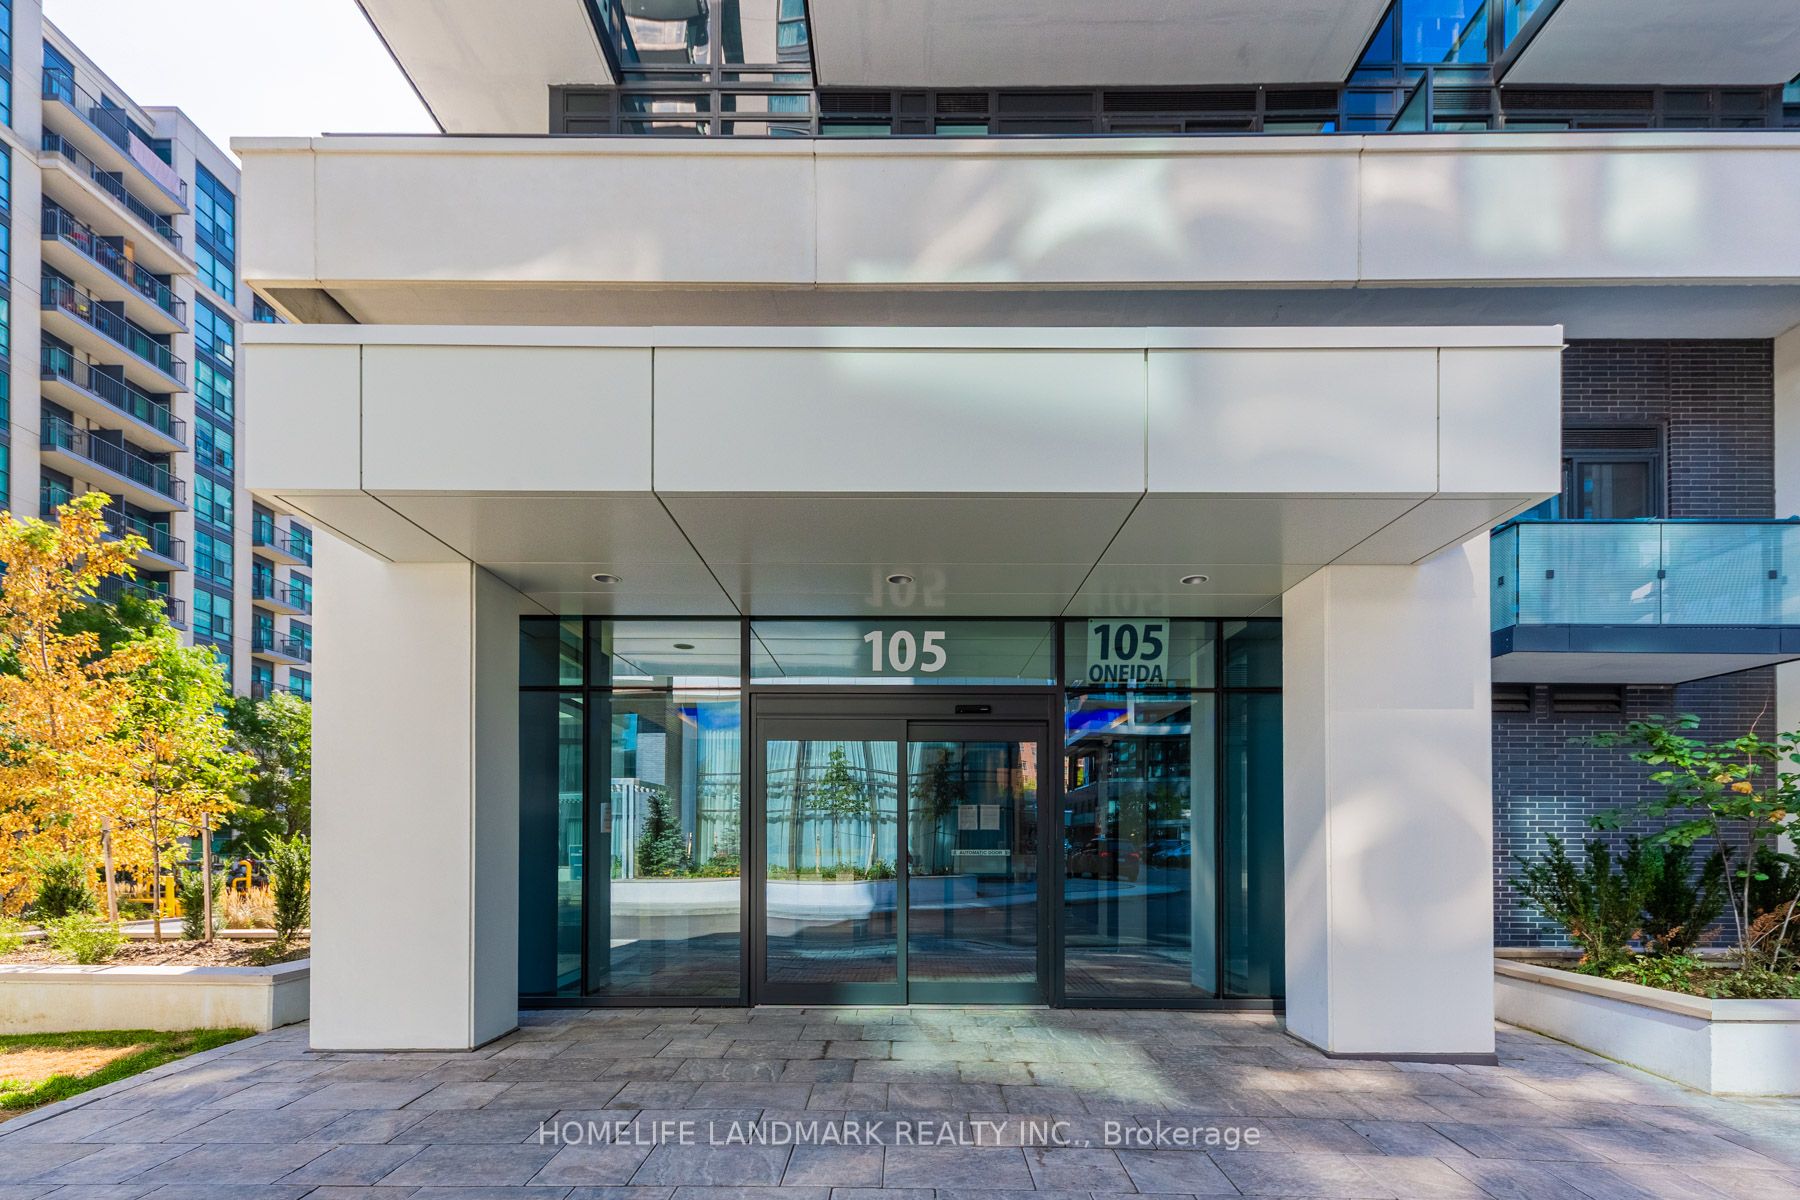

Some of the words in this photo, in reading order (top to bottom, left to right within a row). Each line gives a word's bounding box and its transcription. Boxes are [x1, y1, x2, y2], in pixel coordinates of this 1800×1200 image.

[864, 630, 947, 672] 105
[1094, 624, 1163, 661] 105
[1089, 664, 1163, 682] ONEIDA
